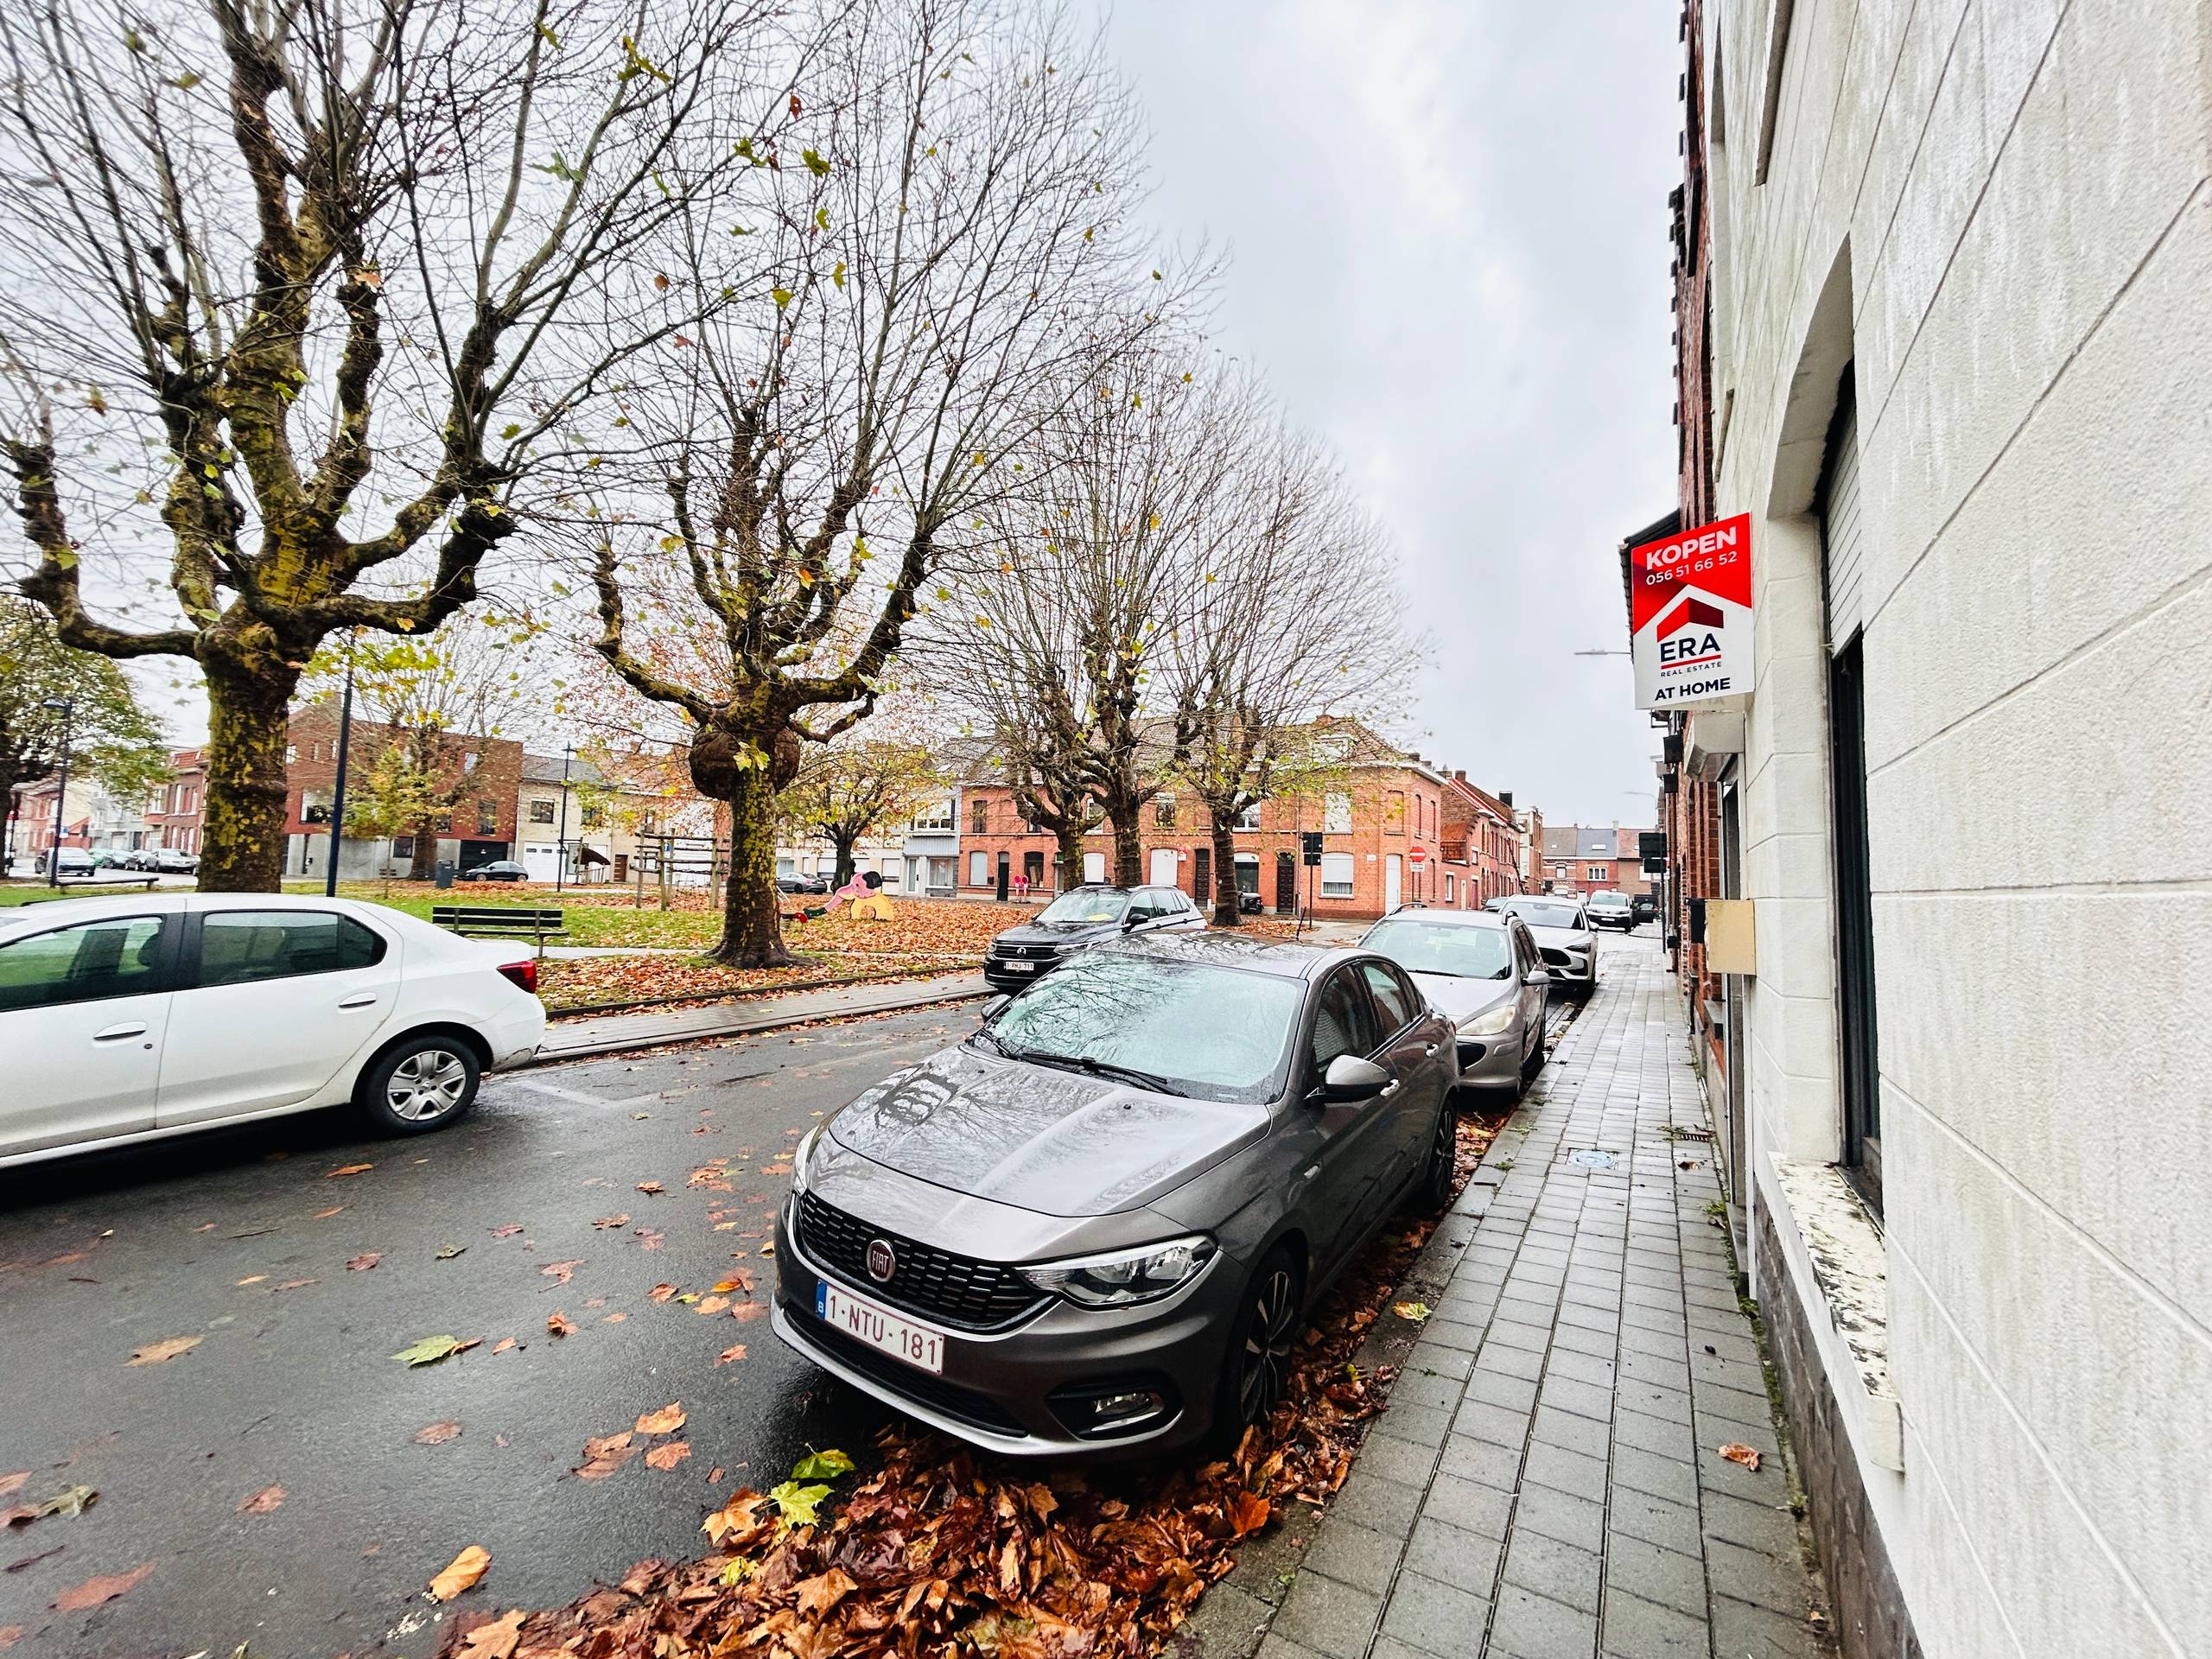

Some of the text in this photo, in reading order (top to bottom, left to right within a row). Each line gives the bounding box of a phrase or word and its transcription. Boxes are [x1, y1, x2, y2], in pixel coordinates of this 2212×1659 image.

[1646, 525, 1737, 570] KOPEN
[1646, 550, 1738, 586] 056 51 66 52
[1660, 632, 1721, 663] ERA
[1661, 661, 1722, 677] REAL ESTATE
[1655, 677, 1731, 701] AT HOME
[872, 1250, 889, 1274] FIAT
[817, 1300, 824, 1313] B
[830, 1294, 937, 1365] 1-NTU-181
